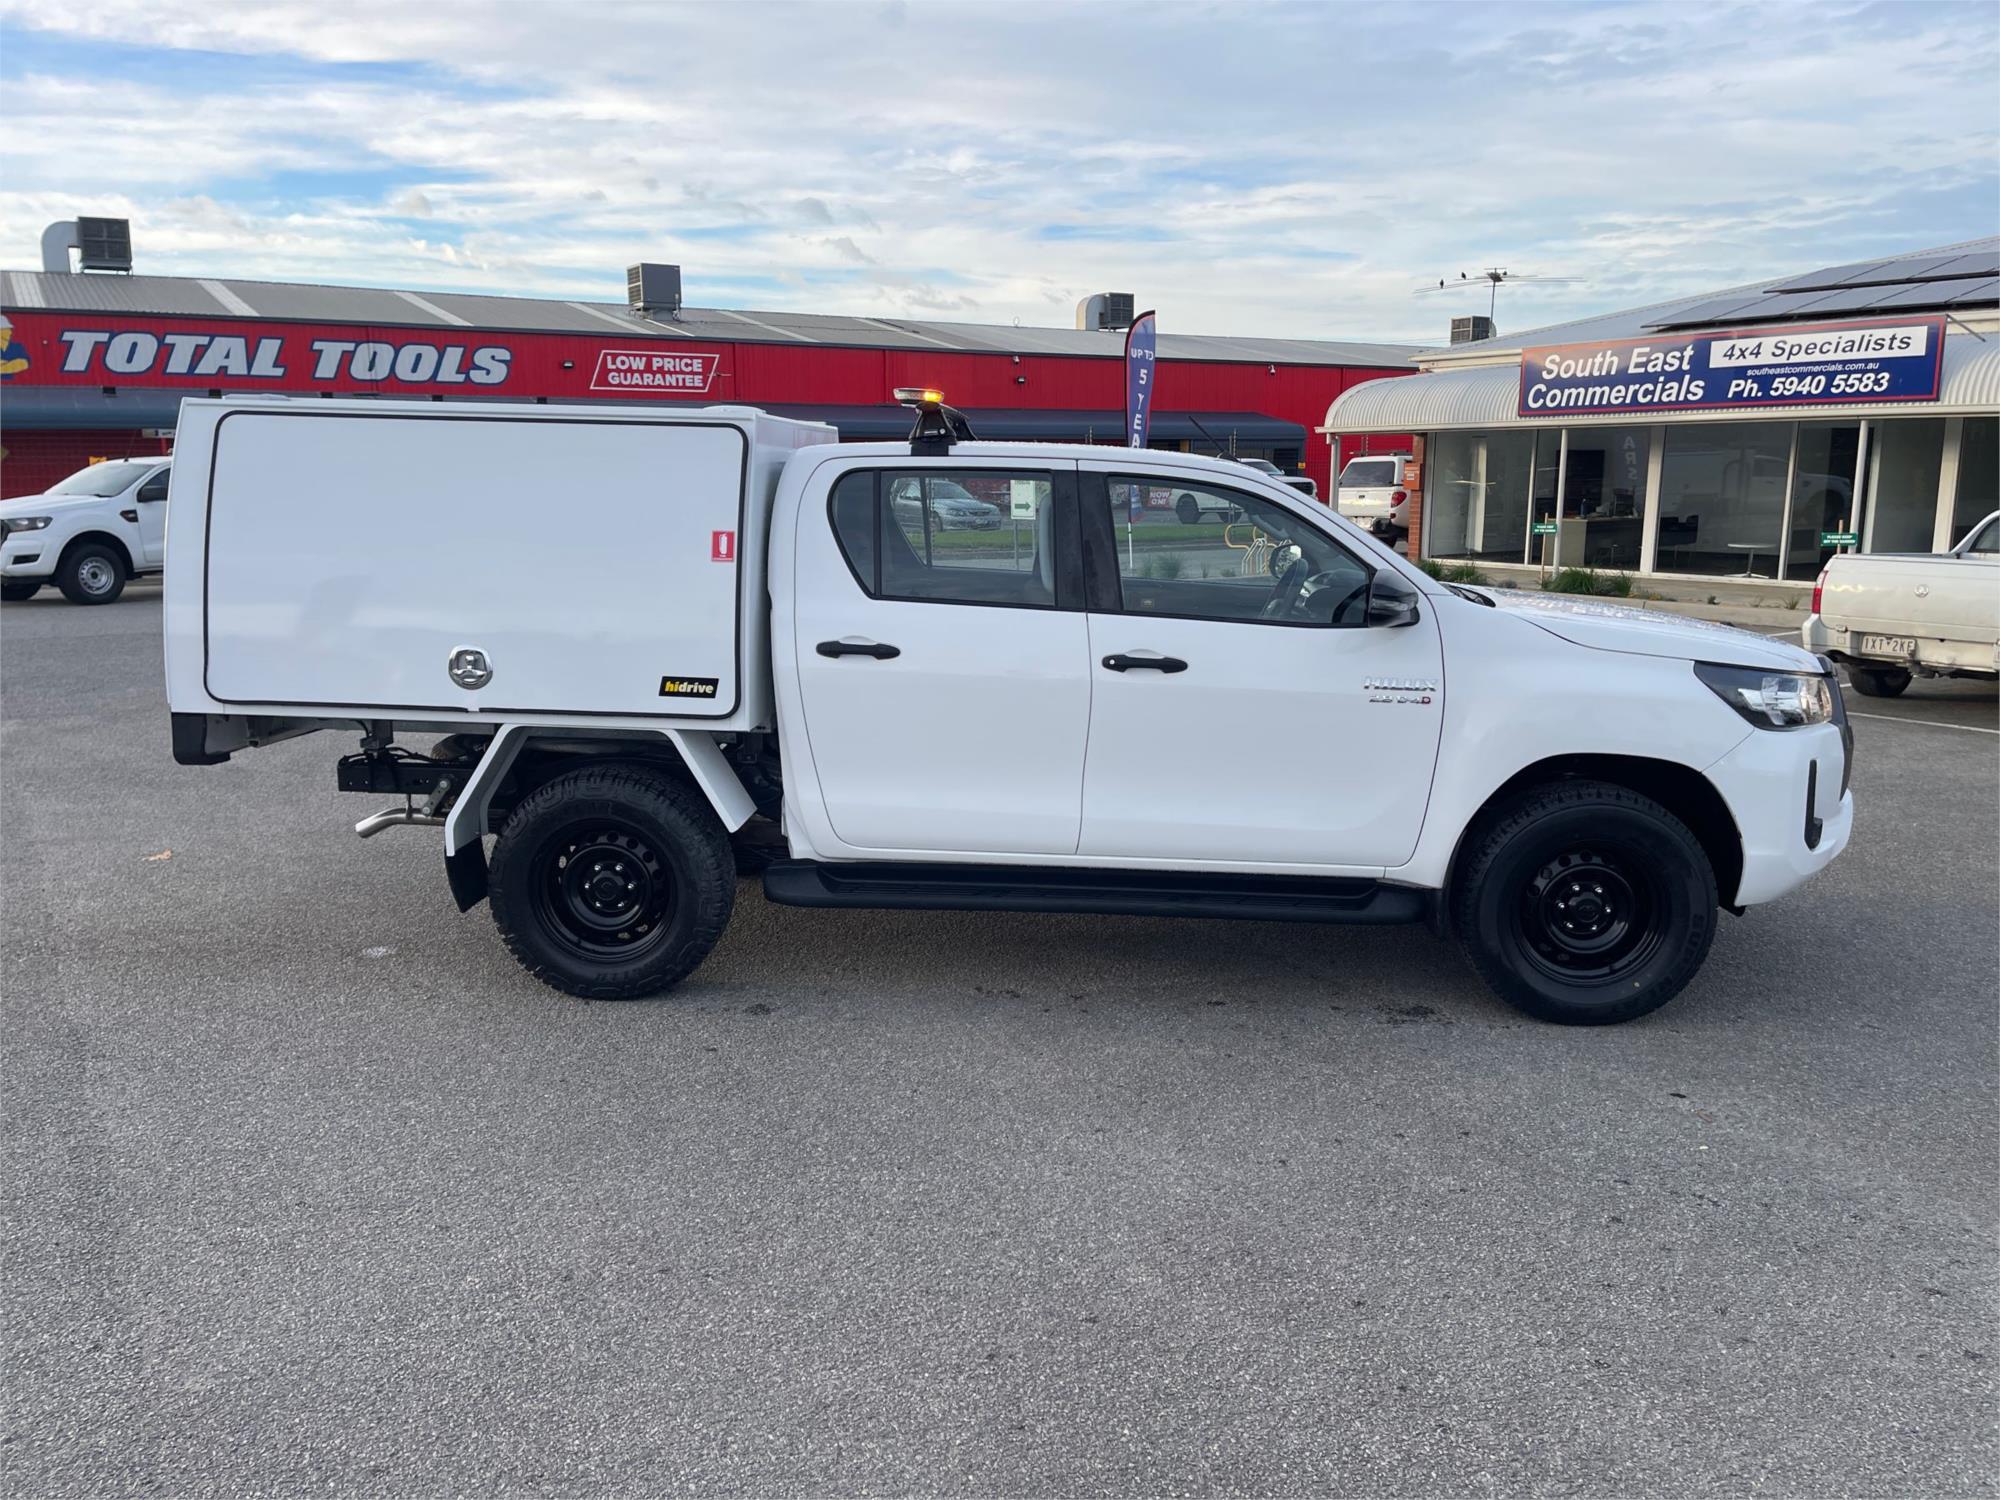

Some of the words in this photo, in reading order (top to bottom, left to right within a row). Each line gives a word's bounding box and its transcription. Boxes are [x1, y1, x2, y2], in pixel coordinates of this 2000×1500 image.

[1131, 347, 1143, 359] UP
[1723, 342, 1763, 361] 4x4
[1771, 332, 1912, 361] Specialists
[60, 330, 286, 378] TOTAL
[311, 340, 512, 385] TOOLS
[606, 355, 647, 370] LOW
[652, 357, 703, 372] PRICE
[1541, 350, 1619, 381] South
[1628, 344, 1694, 375] East
[1138, 368, 1148, 385] 5
[1746, 361, 1880, 377] southeastcommercials.com.au
[607, 372, 704, 387] GUARANTEE
[1727, 380, 1763, 399] Ph.
[1770, 374, 1826, 396] 5940
[1830, 372, 1891, 394] 5583
[1527, 374, 1706, 409] Commercials
[664, 681, 714, 694] hidrive
